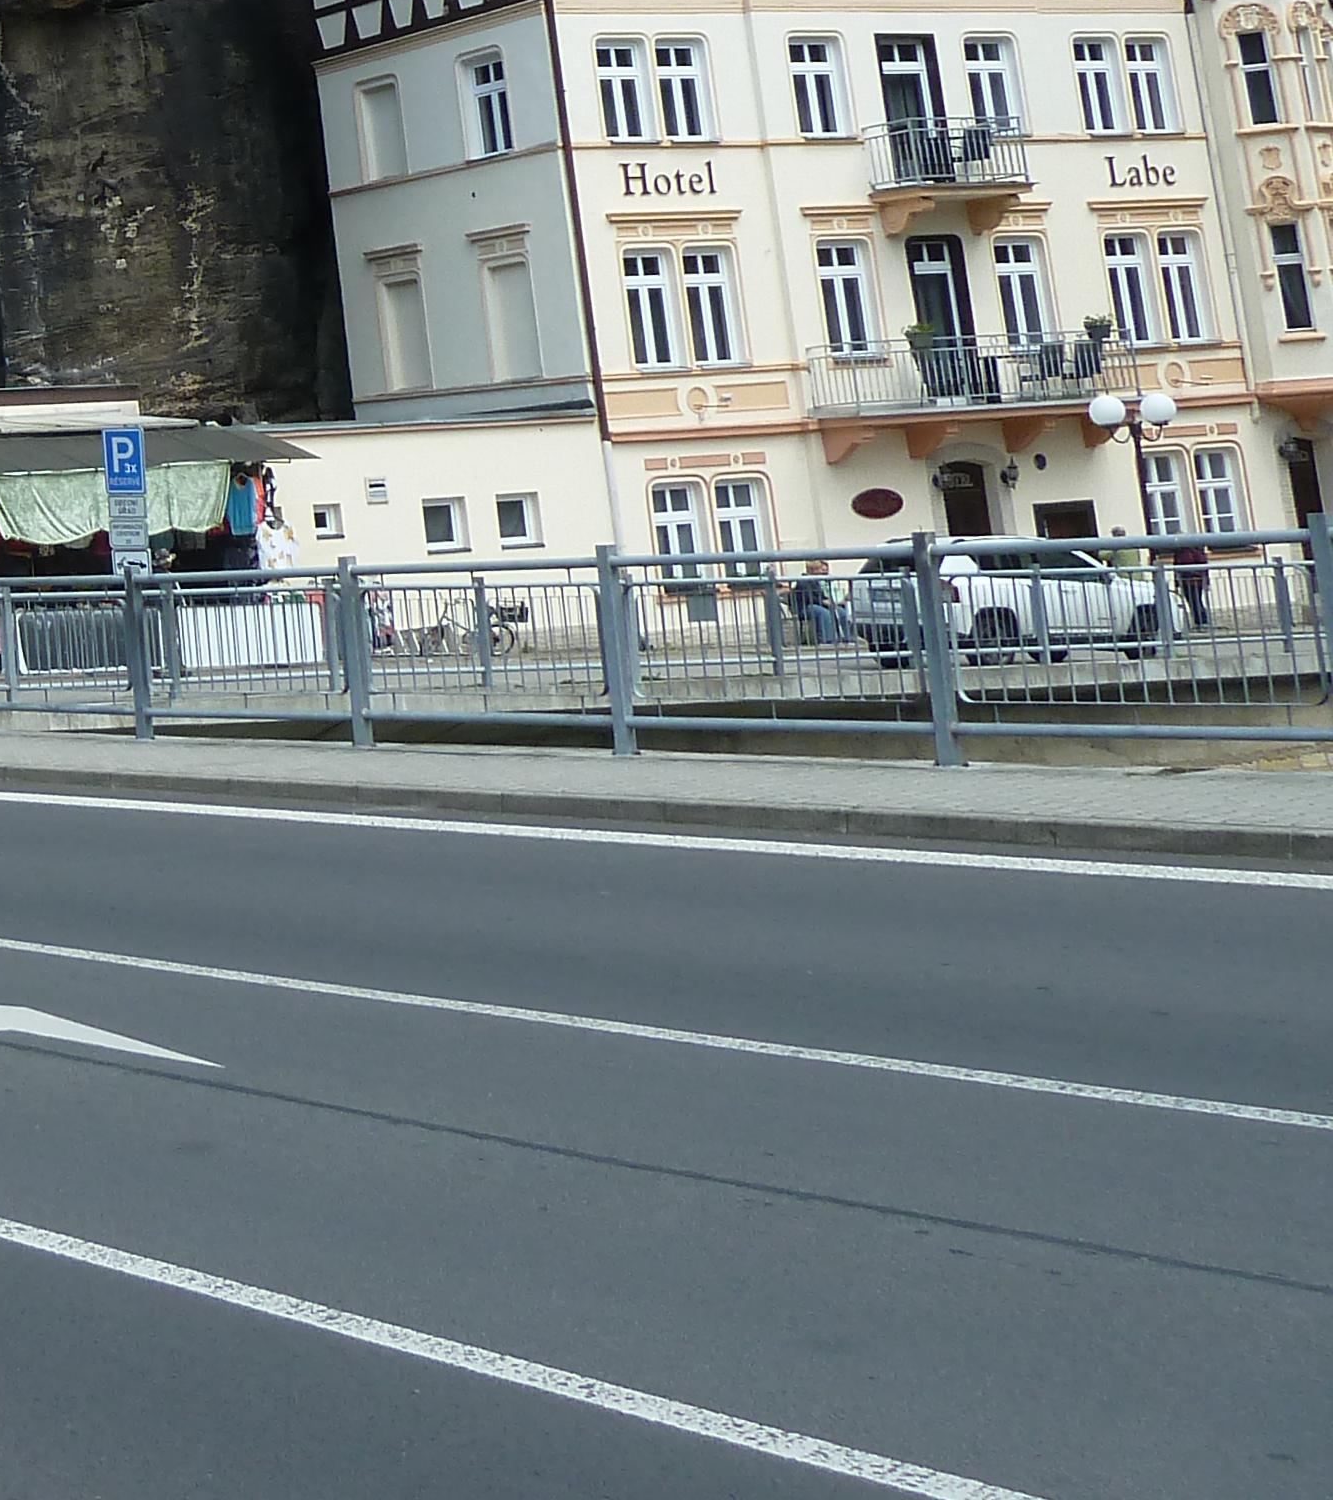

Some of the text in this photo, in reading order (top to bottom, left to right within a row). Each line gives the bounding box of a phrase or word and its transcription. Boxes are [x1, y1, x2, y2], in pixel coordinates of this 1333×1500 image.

[619, 154, 1177, 197] Hotel Labe
[111, 436, 134, 473] P
